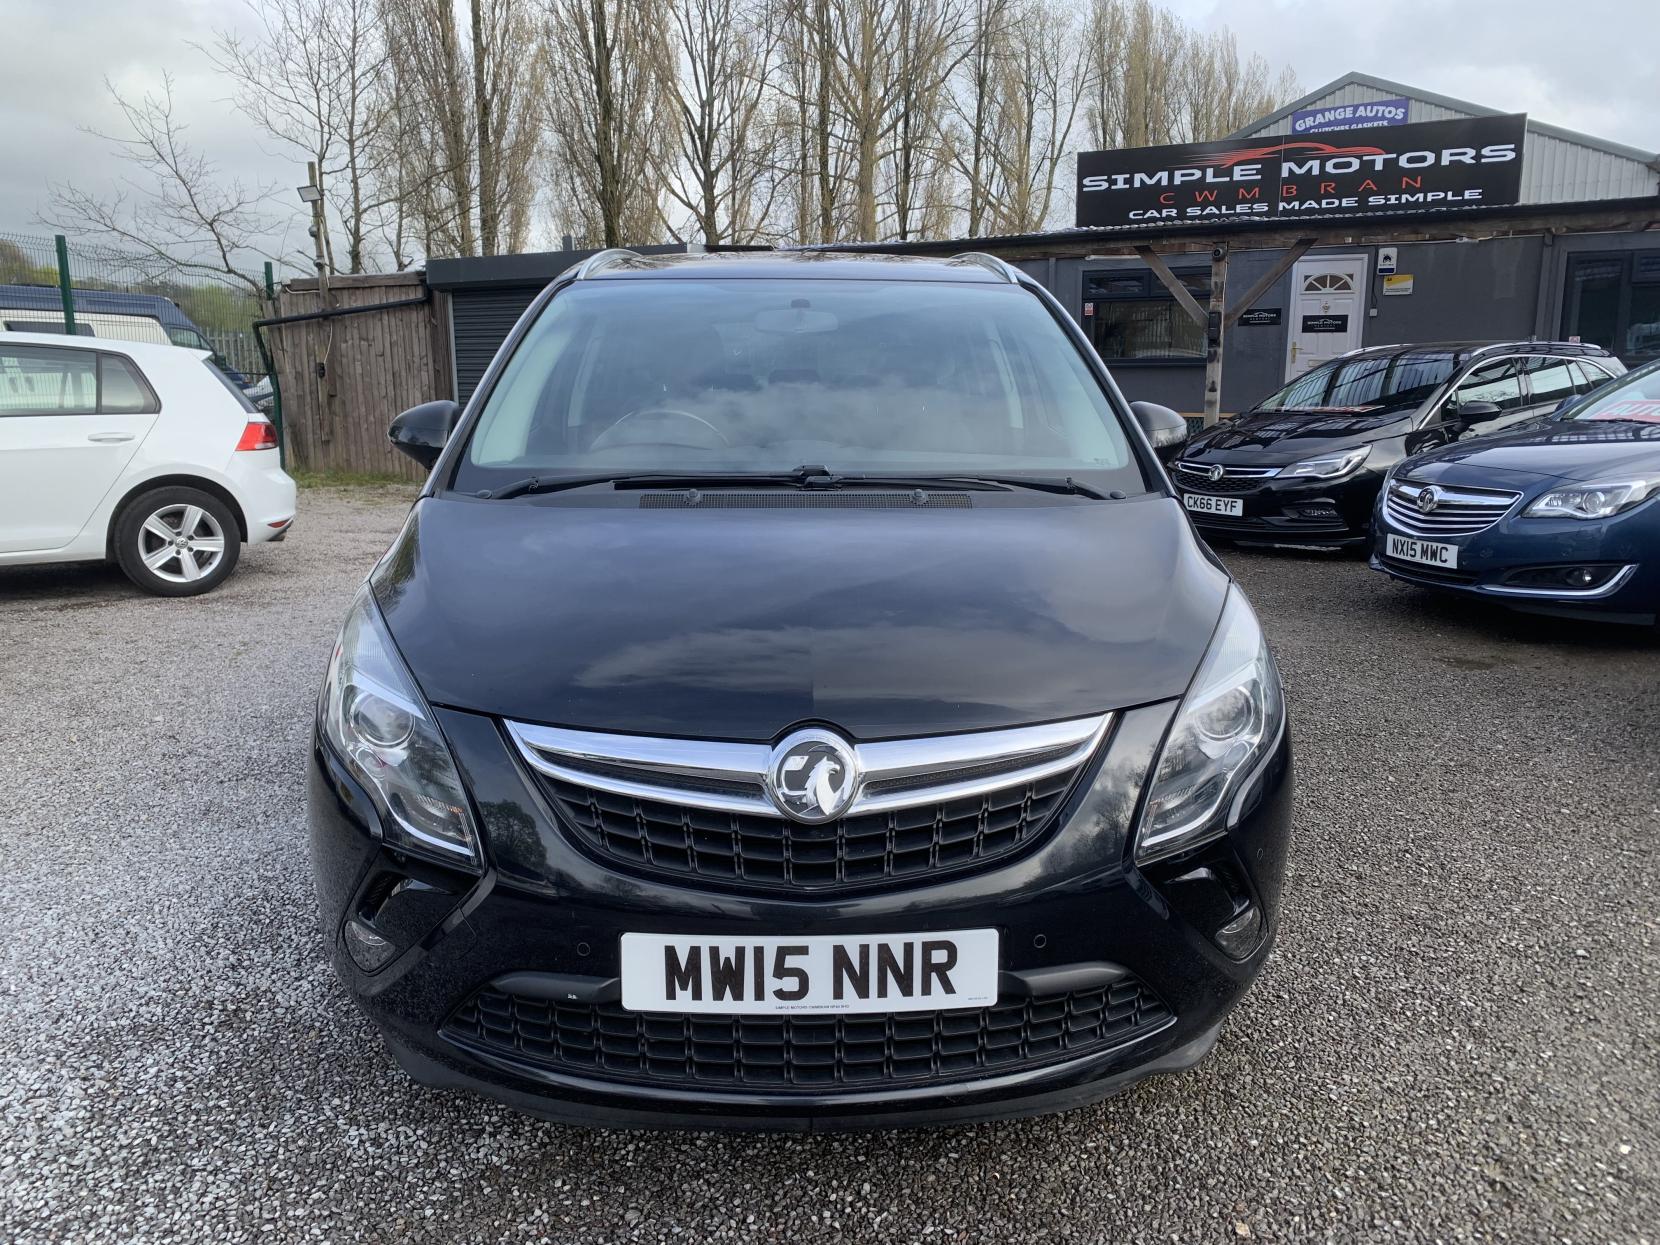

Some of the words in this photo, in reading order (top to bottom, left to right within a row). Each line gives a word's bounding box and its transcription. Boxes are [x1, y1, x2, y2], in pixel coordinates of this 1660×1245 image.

[1295, 107, 1354, 131] GRANGE
[1355, 105, 1406, 120] AUTOS
[1350, 120, 1389, 130] GASKETS
[1082, 164, 1262, 192] SIMPLE
[1281, 143, 1516, 178] MOTORS
[1160, 175, 1422, 204] CWMBRAN
[1128, 208, 1178, 219] CAR
[1186, 202, 1269, 216] SALES
[1278, 197, 1359, 211] MADE
[1368, 189, 1483, 206] SIMPLE
[1186, 494, 1213, 511] CK66
[1215, 498, 1238, 513] EYF
[1392, 537, 1418, 557] NX15
[1420, 543, 1449, 563] MWC
[664, 944, 810, 1002] MW15
[832, 939, 958, 1000] NNR
